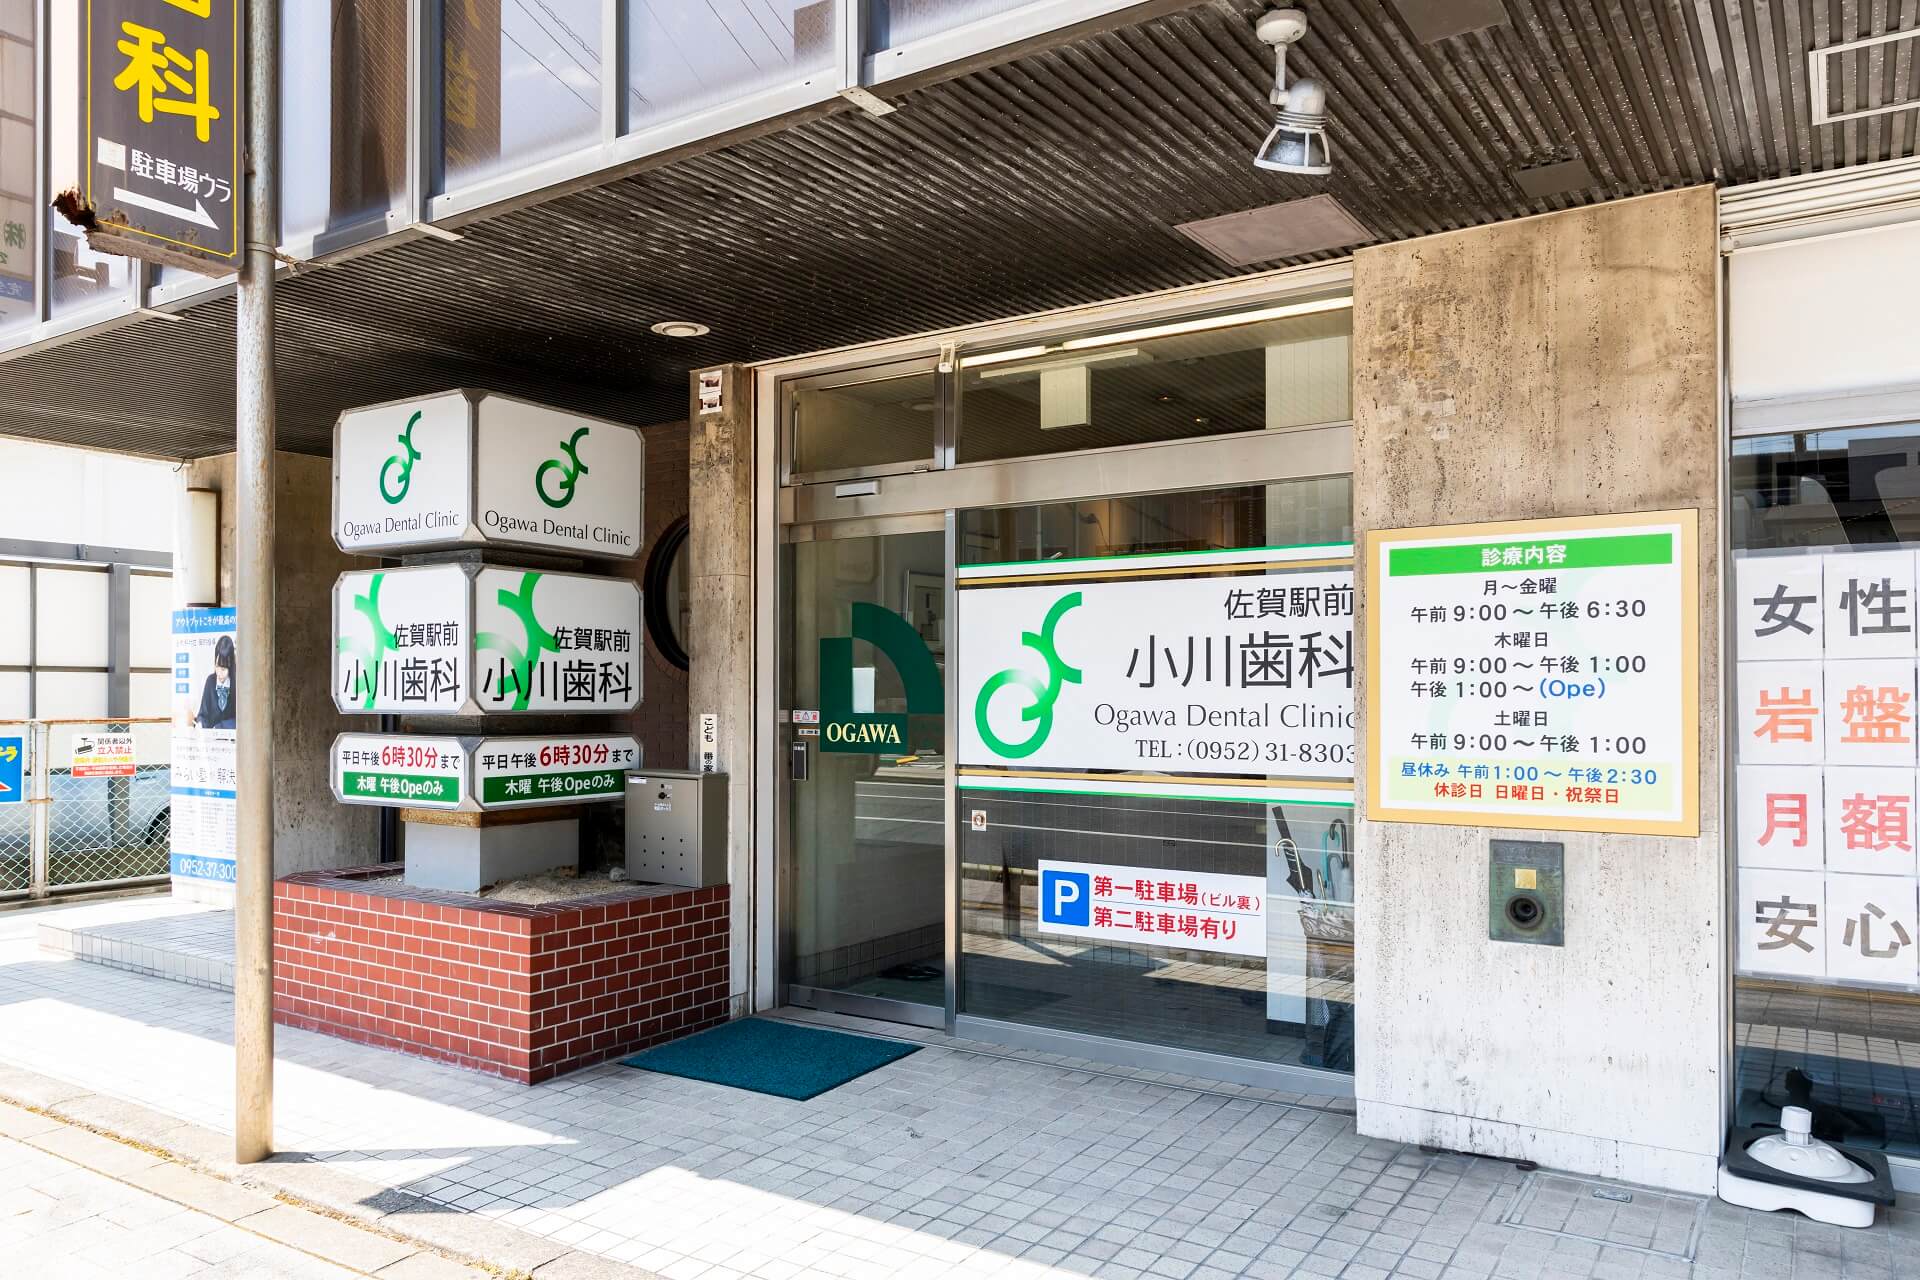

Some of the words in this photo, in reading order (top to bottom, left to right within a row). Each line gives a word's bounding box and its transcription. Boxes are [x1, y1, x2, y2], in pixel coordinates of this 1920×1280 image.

[130, 148, 232, 203] 駐車場ウラ
[344, 519, 381, 541] Ogawa
[385, 513, 421, 534] Dental
[425, 510, 459, 529] Clinic
[485, 510, 538, 535] Ogawa
[543, 519, 588, 540] Dental
[592, 527, 631, 547] Clinic
[1482, 544, 1567, 567] 診療内容
[1224, 583, 1354, 620] 佐賀駅前
[1411, 606, 1447, 623] 午前
[1453, 604, 1507, 621] 9:00
[1539, 601, 1580, 620] 午後
[1587, 599, 1646, 618] 6:30
[1753, 577, 1911, 637] 女性
[393, 620, 459, 649] 佐賀駅前
[553, 625, 631, 653] 佐賀駅前
[1494, 631, 1548, 648] 木曜日
[1126, 630, 1354, 689] 小川歯科
[1411, 657, 1447, 675] 午前
[1453, 657, 1507, 674] 9:00
[1539, 655, 1580, 674] 午後
[1590, 655, 1646, 673] 1:00
[344, 656, 460, 702] 小川歯科
[483, 657, 632, 703] 小川歯科
[1411, 681, 1447, 698] 午後
[1456, 681, 1507, 698] 1:00
[1539, 679, 1606, 700] (Ope)
[1094, 703, 1177, 732] Ogawa
[1188, 703, 1269, 728] Dental
[1494, 710, 1548, 727] 土曜日
[1753, 685, 1911, 744] 岩盤
[704, 717, 714, 743] こども
[826, 722, 901, 744] OGAWA
[1411, 733, 1447, 751] 午前
[1453, 734, 1507, 751] 9:00
[1539, 734, 1580, 753] 午後
[1590, 736, 1646, 754] 1:00
[97, 745, 132, 755] 立入禁止
[1401, 762, 1450, 778] 昼休み
[357, 776, 377, 793] 木曜
[505, 778, 532, 796] 木曜
[1434, 783, 1483, 799] 休診日
[1757, 793, 1912, 852] 月額
[1054, 879, 1080, 917] P
[1093, 906, 1237, 941] 第二駐車場有り
[1755, 895, 1912, 958] 安心
